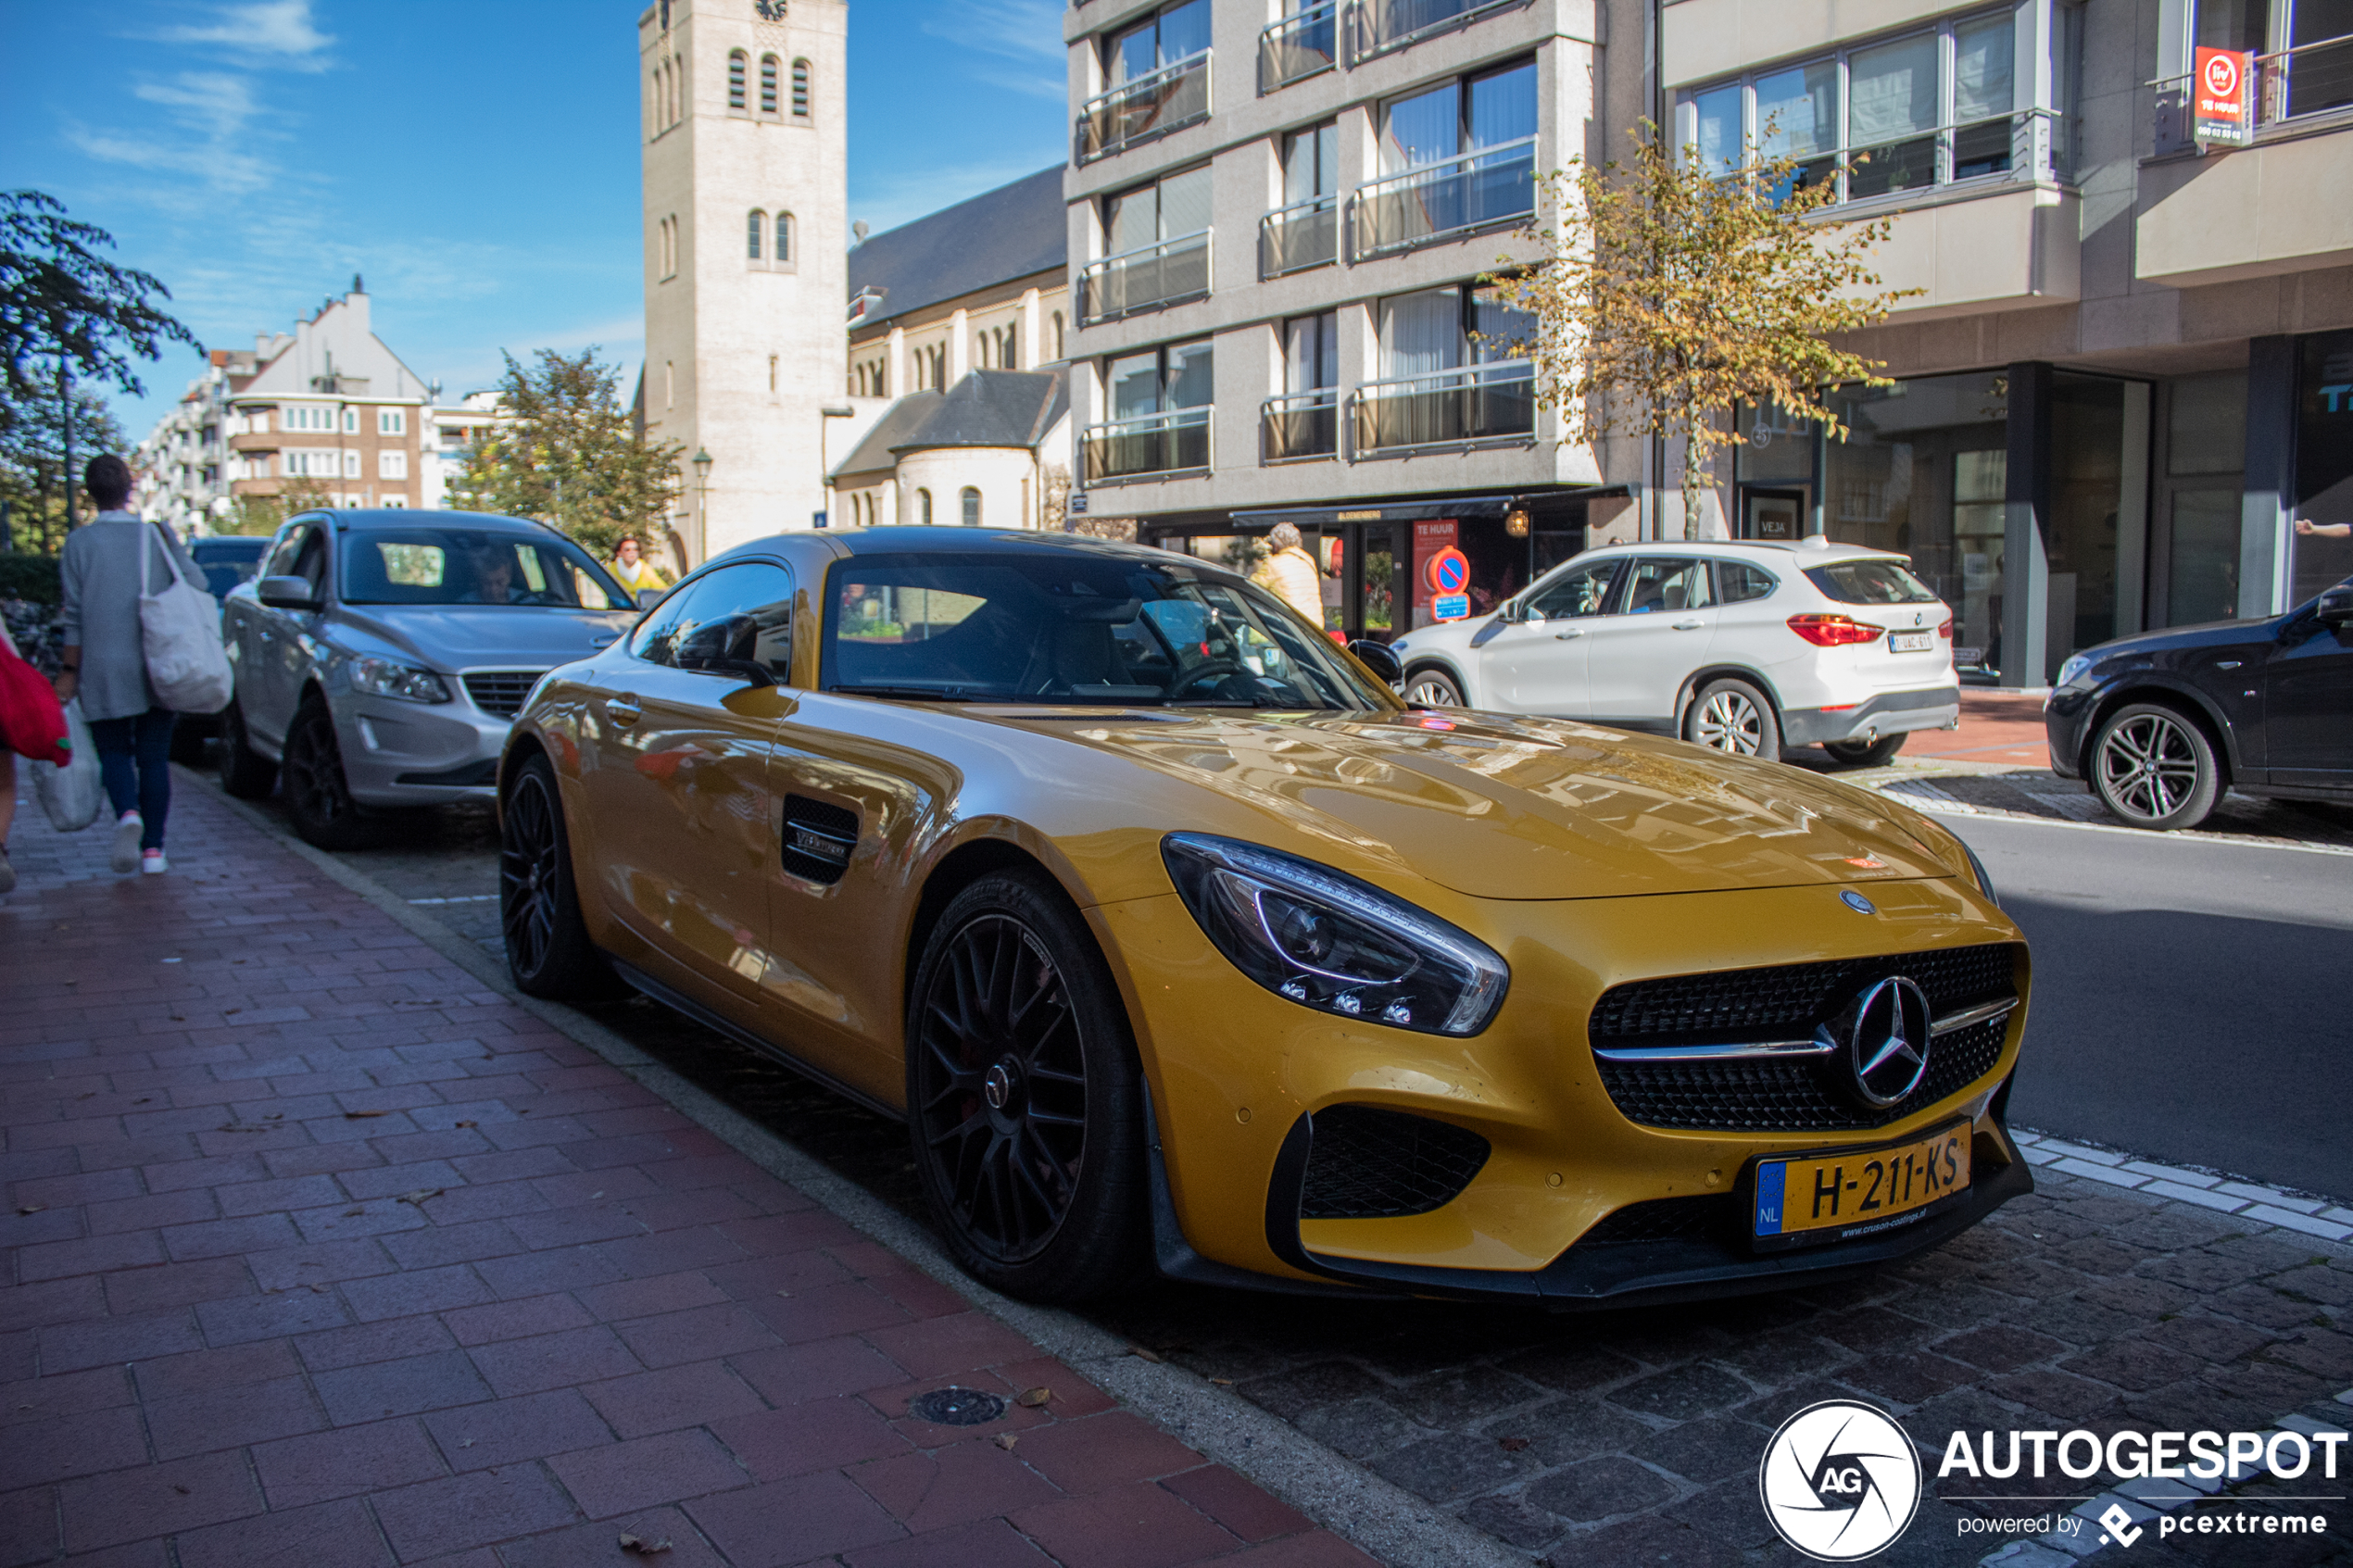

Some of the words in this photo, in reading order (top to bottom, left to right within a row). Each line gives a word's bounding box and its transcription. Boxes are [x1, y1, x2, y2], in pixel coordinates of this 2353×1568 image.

[2201, 99, 2214, 111] TE
[2215, 102, 2239, 115] HUUR
[1417, 525, 1428, 534] TE
[1429, 524, 1454, 534] HUUR
[1762, 521, 1786, 533] VEJA
[1895, 635, 1931, 649] 1-UAC-611
[1812, 1138, 1957, 1219] H-211-KS
[1760, 1207, 1779, 1223] NL
[1842, 1208, 1927, 1238] www.cruson-coatings.nl
